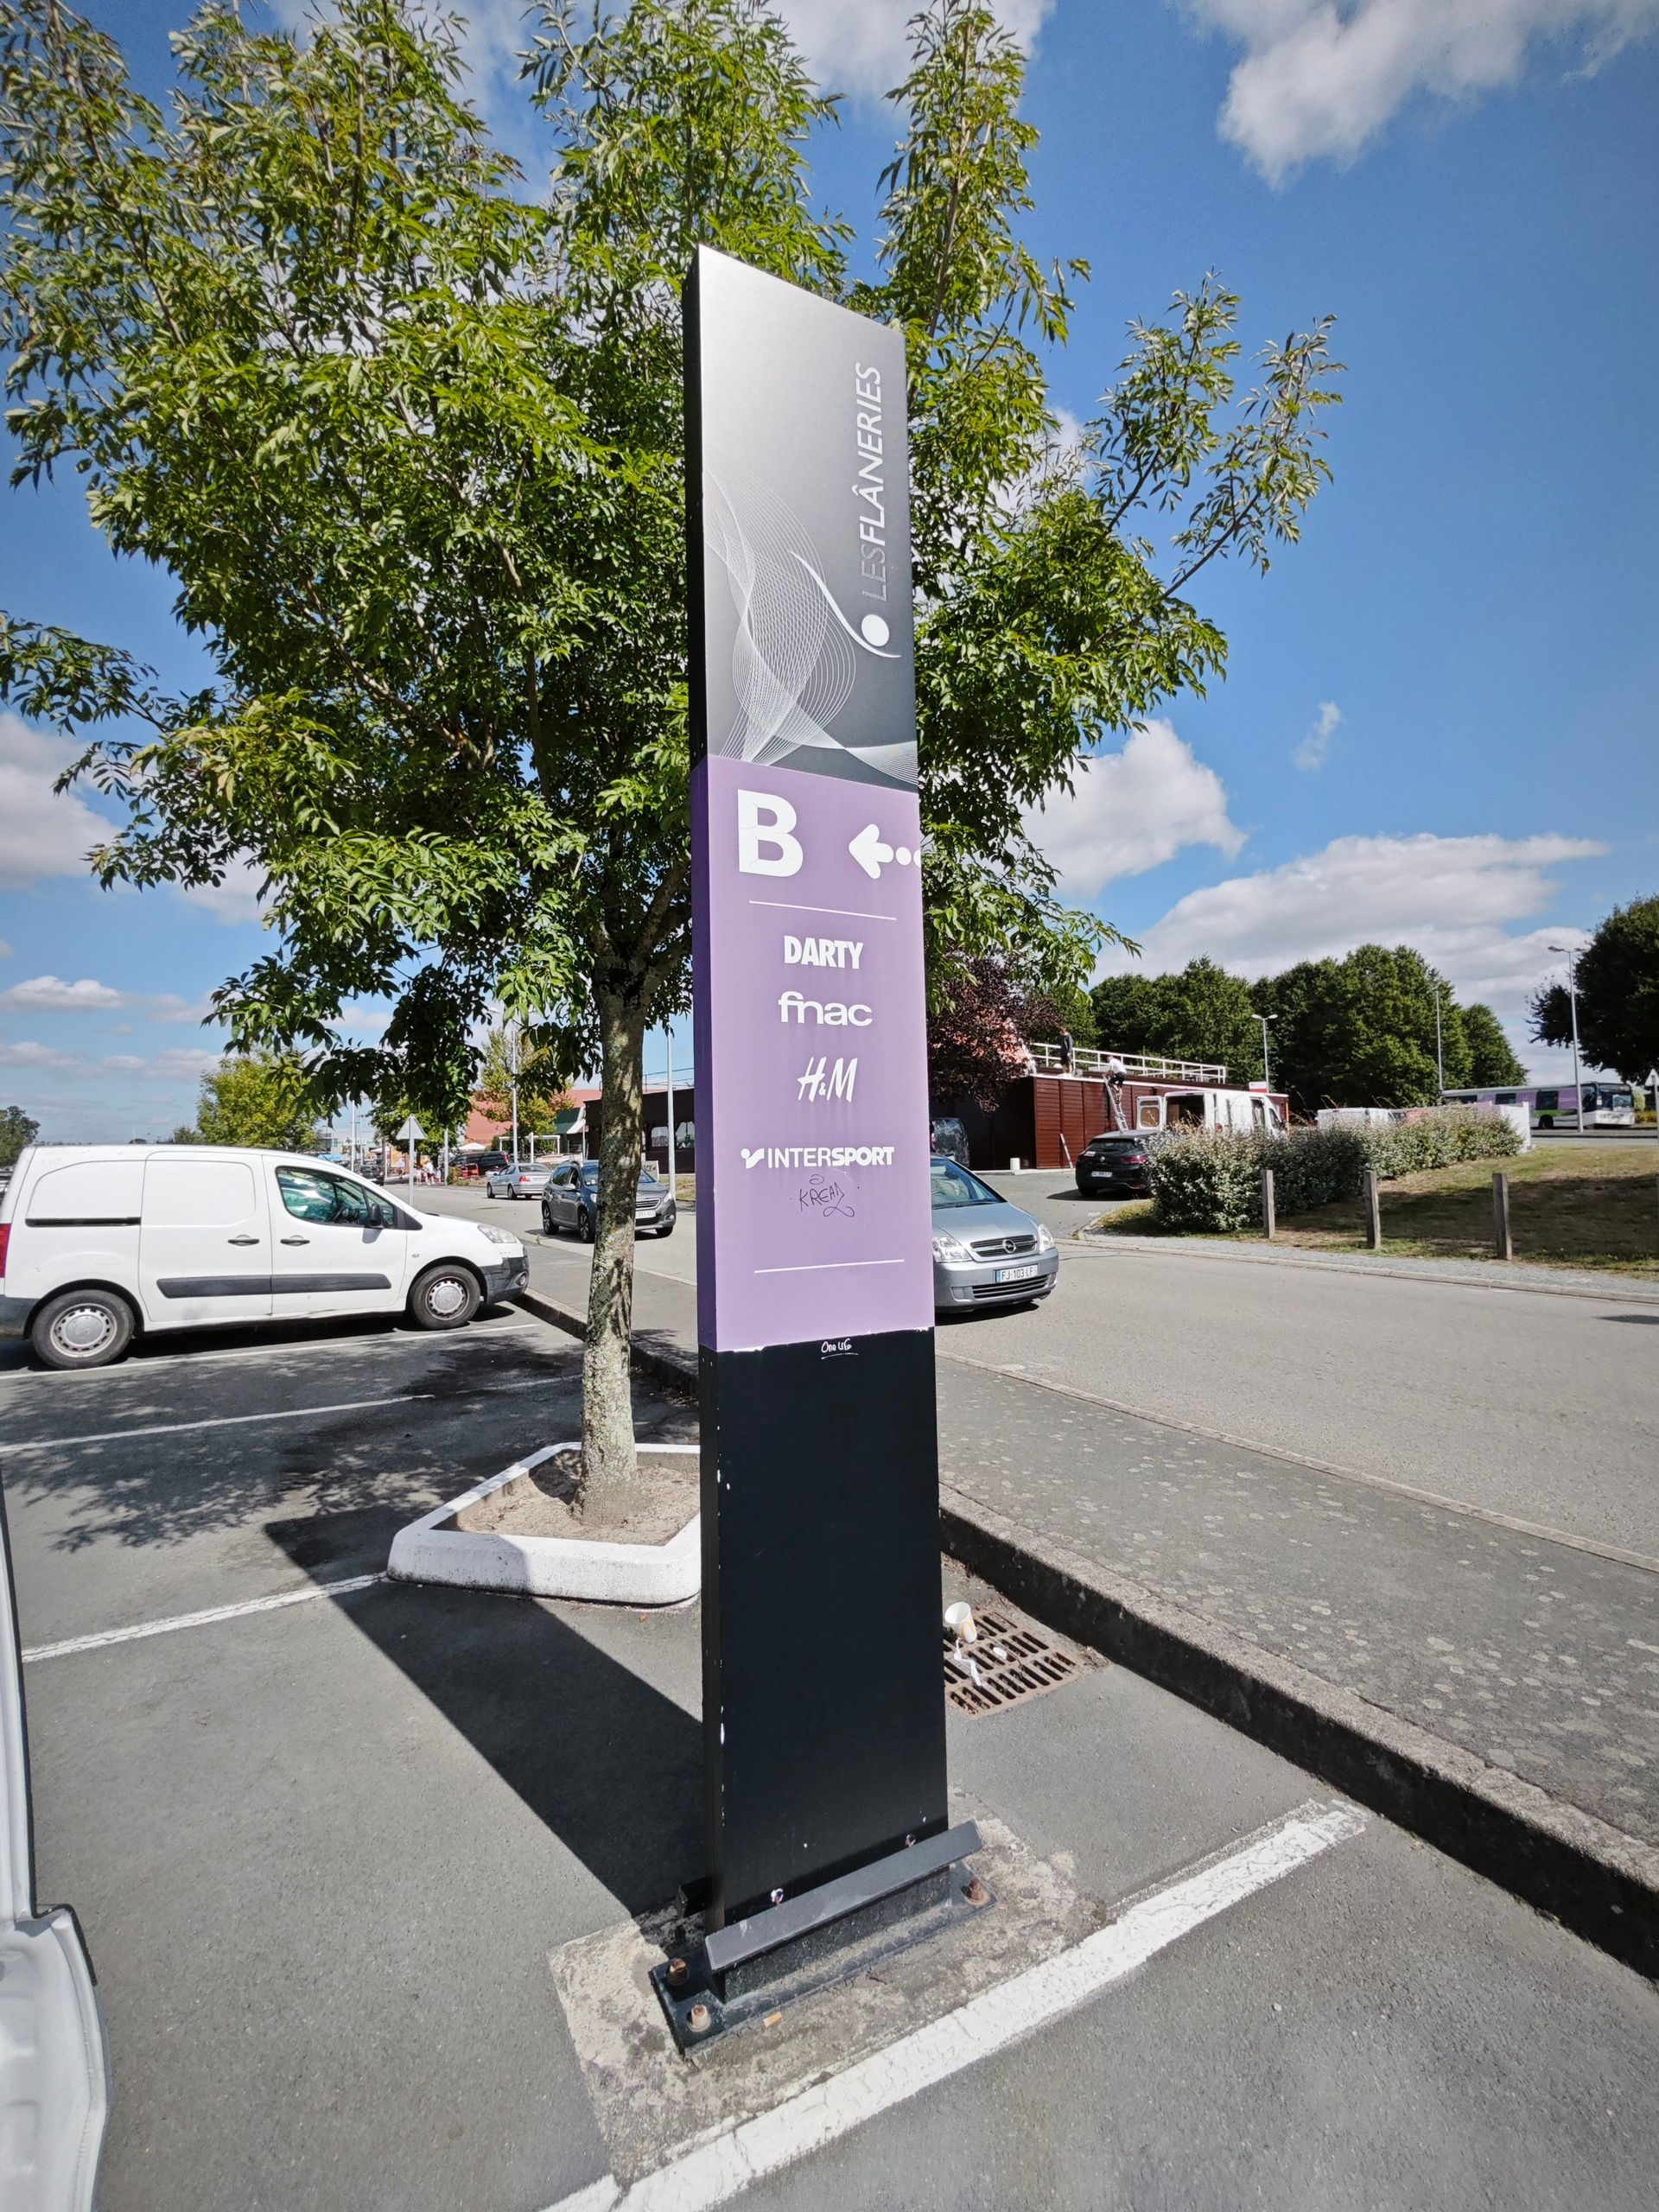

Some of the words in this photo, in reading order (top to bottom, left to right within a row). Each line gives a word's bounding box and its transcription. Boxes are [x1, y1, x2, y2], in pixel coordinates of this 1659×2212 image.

[737, 789, 804, 877] B
[784, 935, 864, 969] DARTY
[778, 991, 873, 1027] fnac
[797, 1057, 858, 1103] H&M
[767, 1147, 895, 1168] INTERSPORT
[820, 1340, 836, 1353] One
